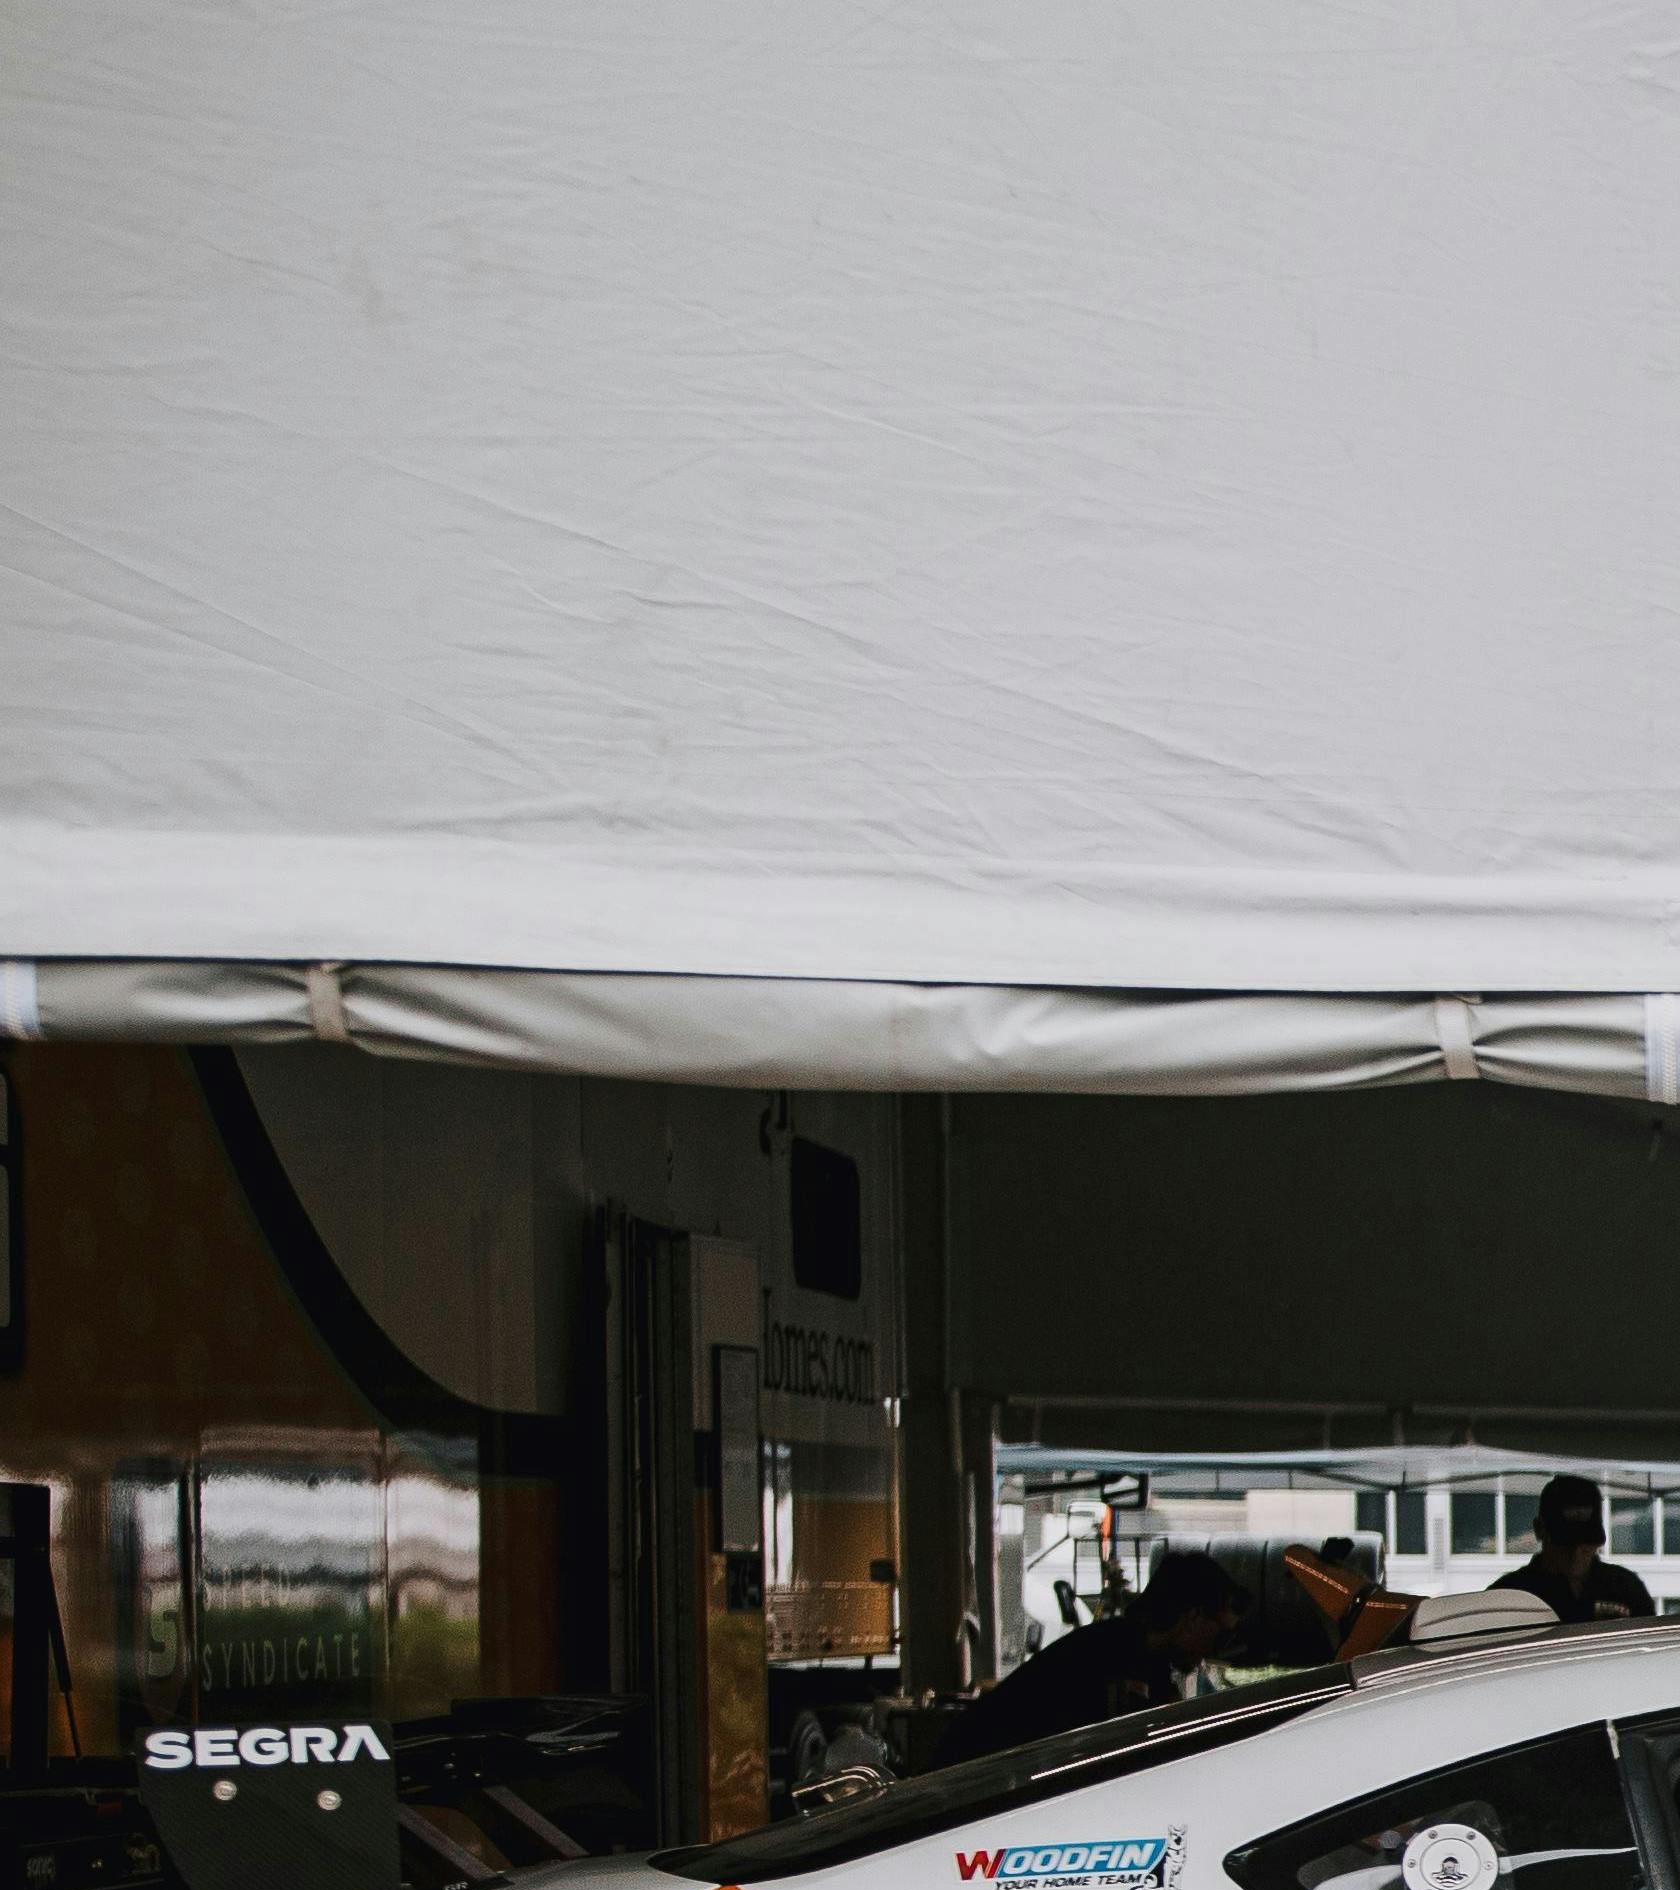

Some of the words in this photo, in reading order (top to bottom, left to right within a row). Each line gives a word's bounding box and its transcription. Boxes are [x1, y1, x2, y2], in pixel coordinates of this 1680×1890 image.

[202, 1632, 360, 1692] SYNDICATE
[144, 1723, 391, 1772] SEGRA
[955, 1840, 1156, 1881] WOODFIN
[995, 1879, 1037, 1890] YOUR
[1042, 1876, 1091, 1889] HOME
[1097, 1873, 1141, 1886] TEAM
